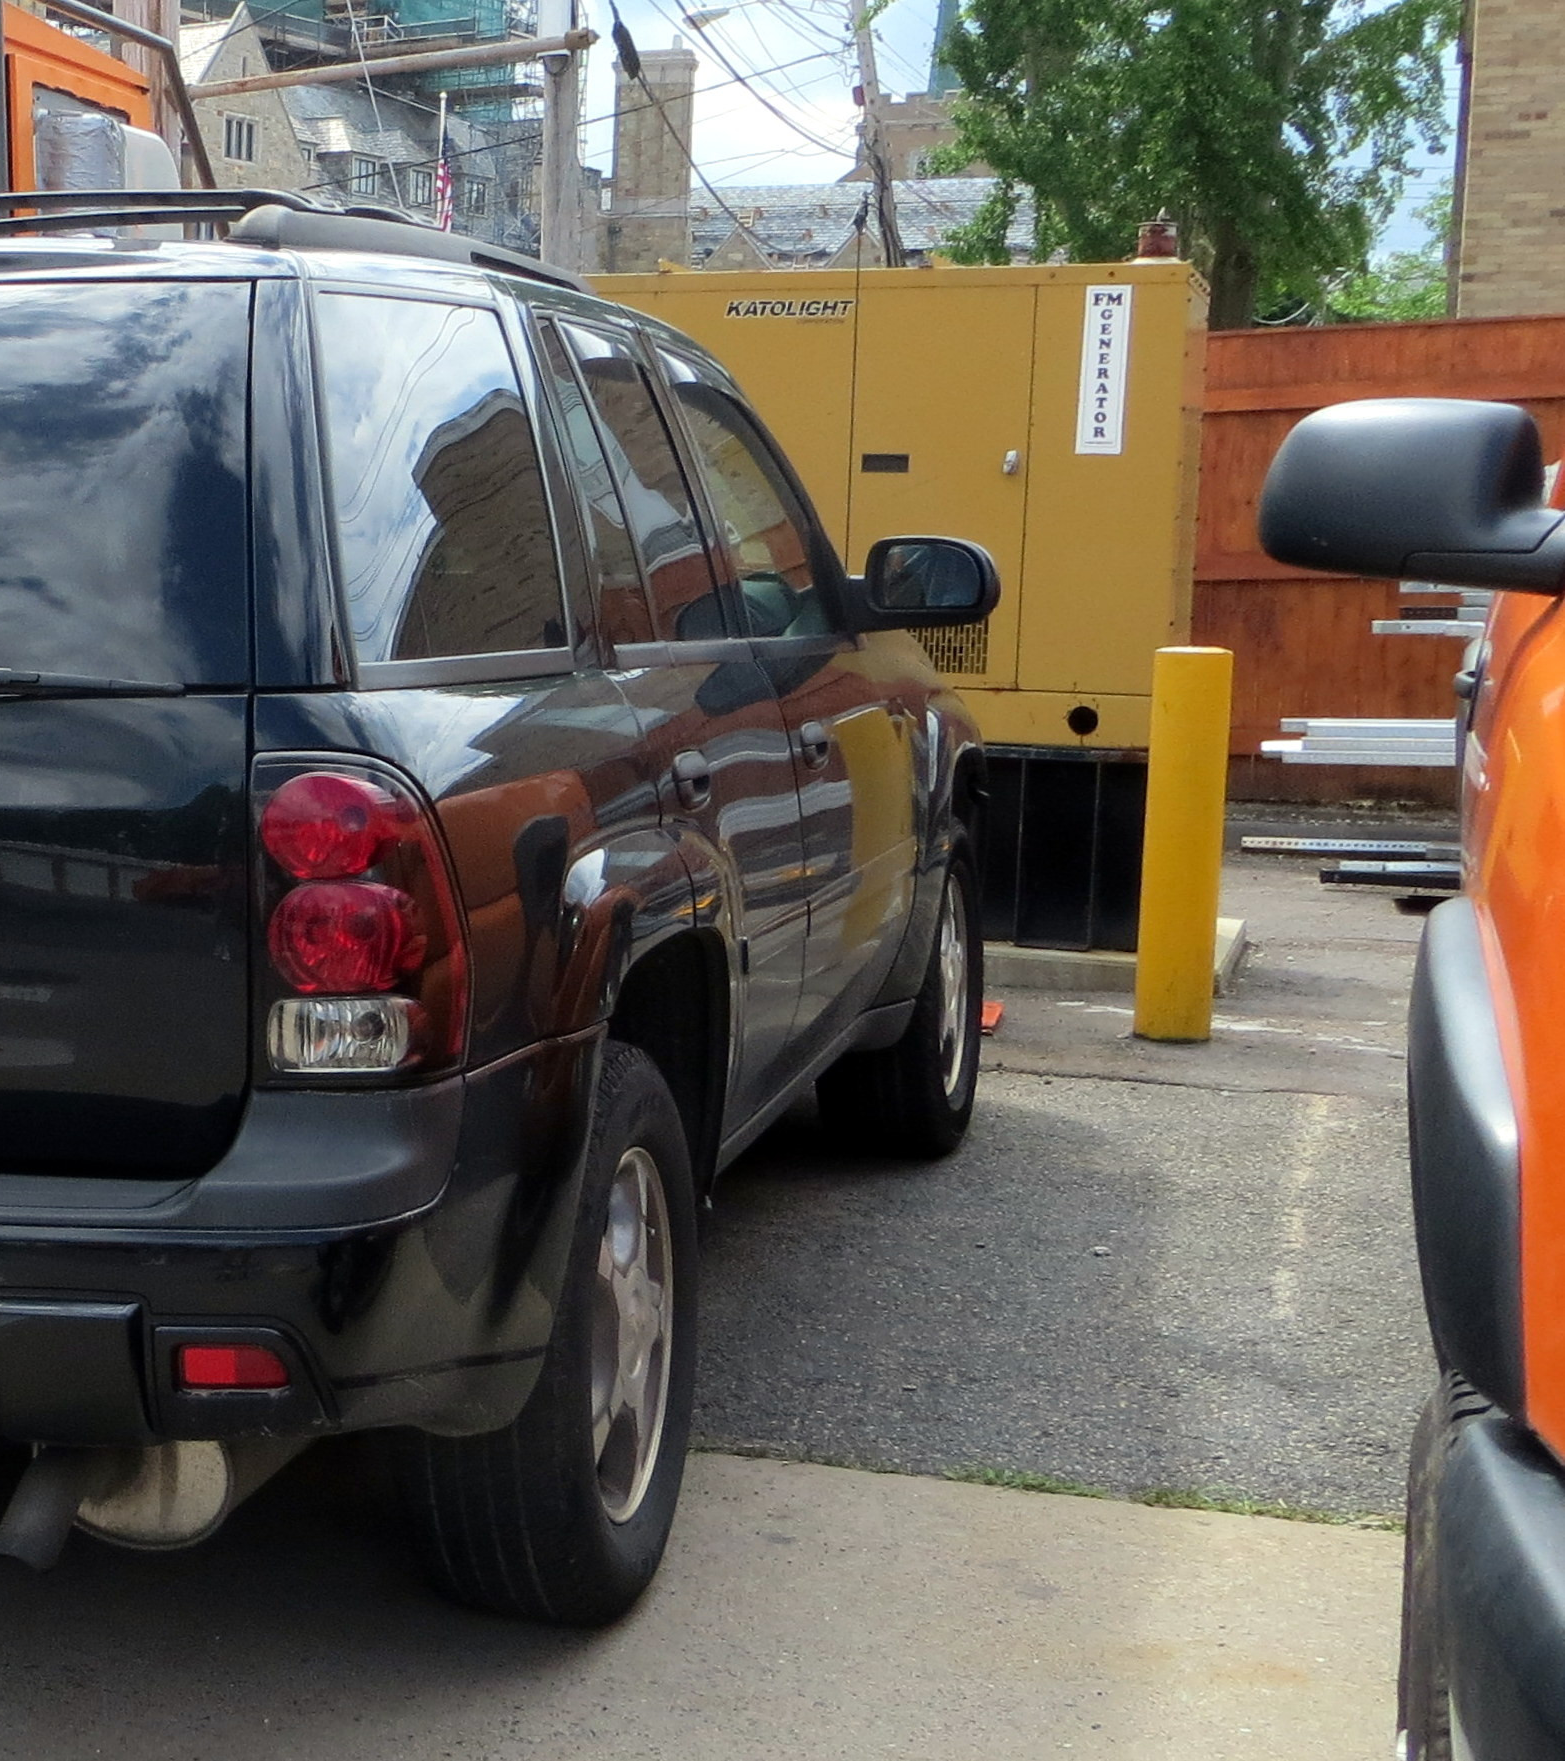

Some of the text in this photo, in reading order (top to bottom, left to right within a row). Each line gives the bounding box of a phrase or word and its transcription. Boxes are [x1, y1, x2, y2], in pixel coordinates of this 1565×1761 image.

[1092, 292, 1123, 307] FM
[725, 300, 854, 317] KATOLIGHT
[1093, 308, 1113, 438] GENERATOR
